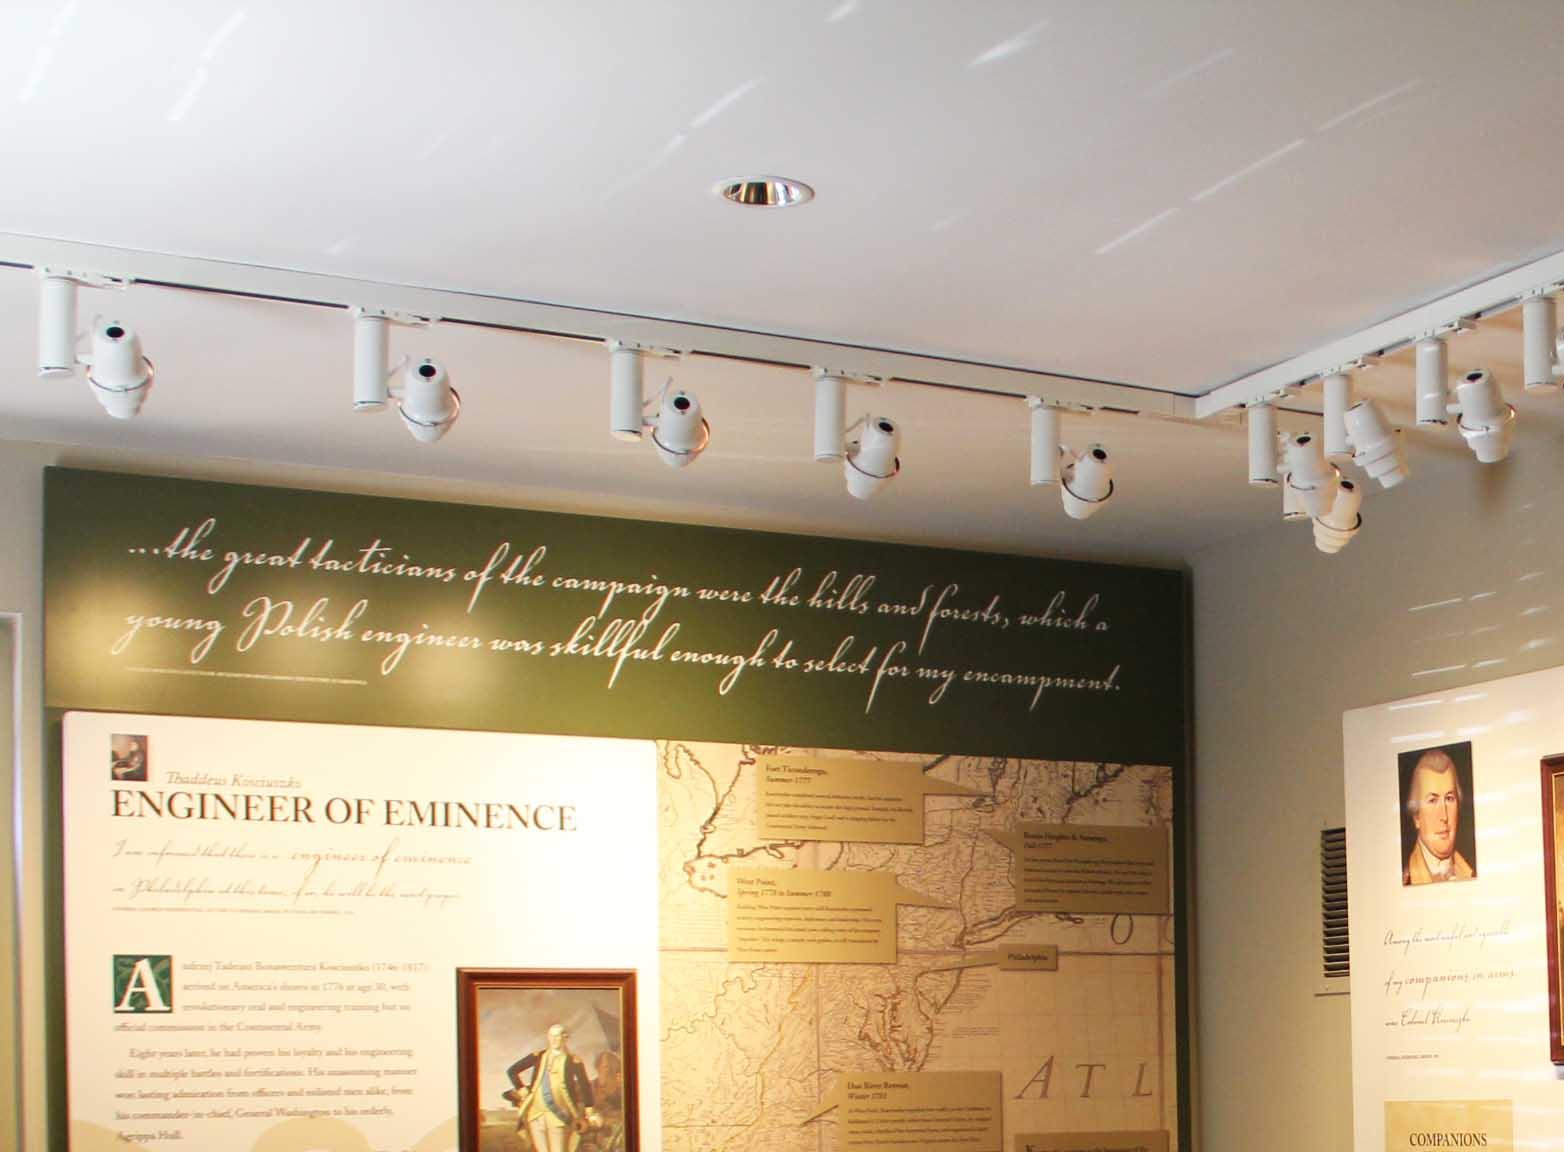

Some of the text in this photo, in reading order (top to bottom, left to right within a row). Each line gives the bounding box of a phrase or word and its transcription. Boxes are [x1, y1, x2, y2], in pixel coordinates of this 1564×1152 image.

[208, 538, 311, 595] great
[310, 538, 457, 583] tacticians
[464, 542, 511, 613] of
[502, 545, 547, 588] the
[552, 574, 691, 622] campaign
[697, 586, 752, 604] were
[759, 567, 802, 608] the
[807, 571, 876, 614] hills
[877, 585, 934, 617] and
[917, 584, 1010, 656] forests,
[1017, 592, 1100, 633] which
[1095, 620, 1110, 632] a
[111, 596, 1121, 715] young Polish engineer was skillful enough to select for my encampment.
[165, 772, 227, 786] Thaddeus
[111, 789, 578, 832] ENGINEER OF EMINENCE
[1409, 1132, 1488, 1147] COMPANIONS
